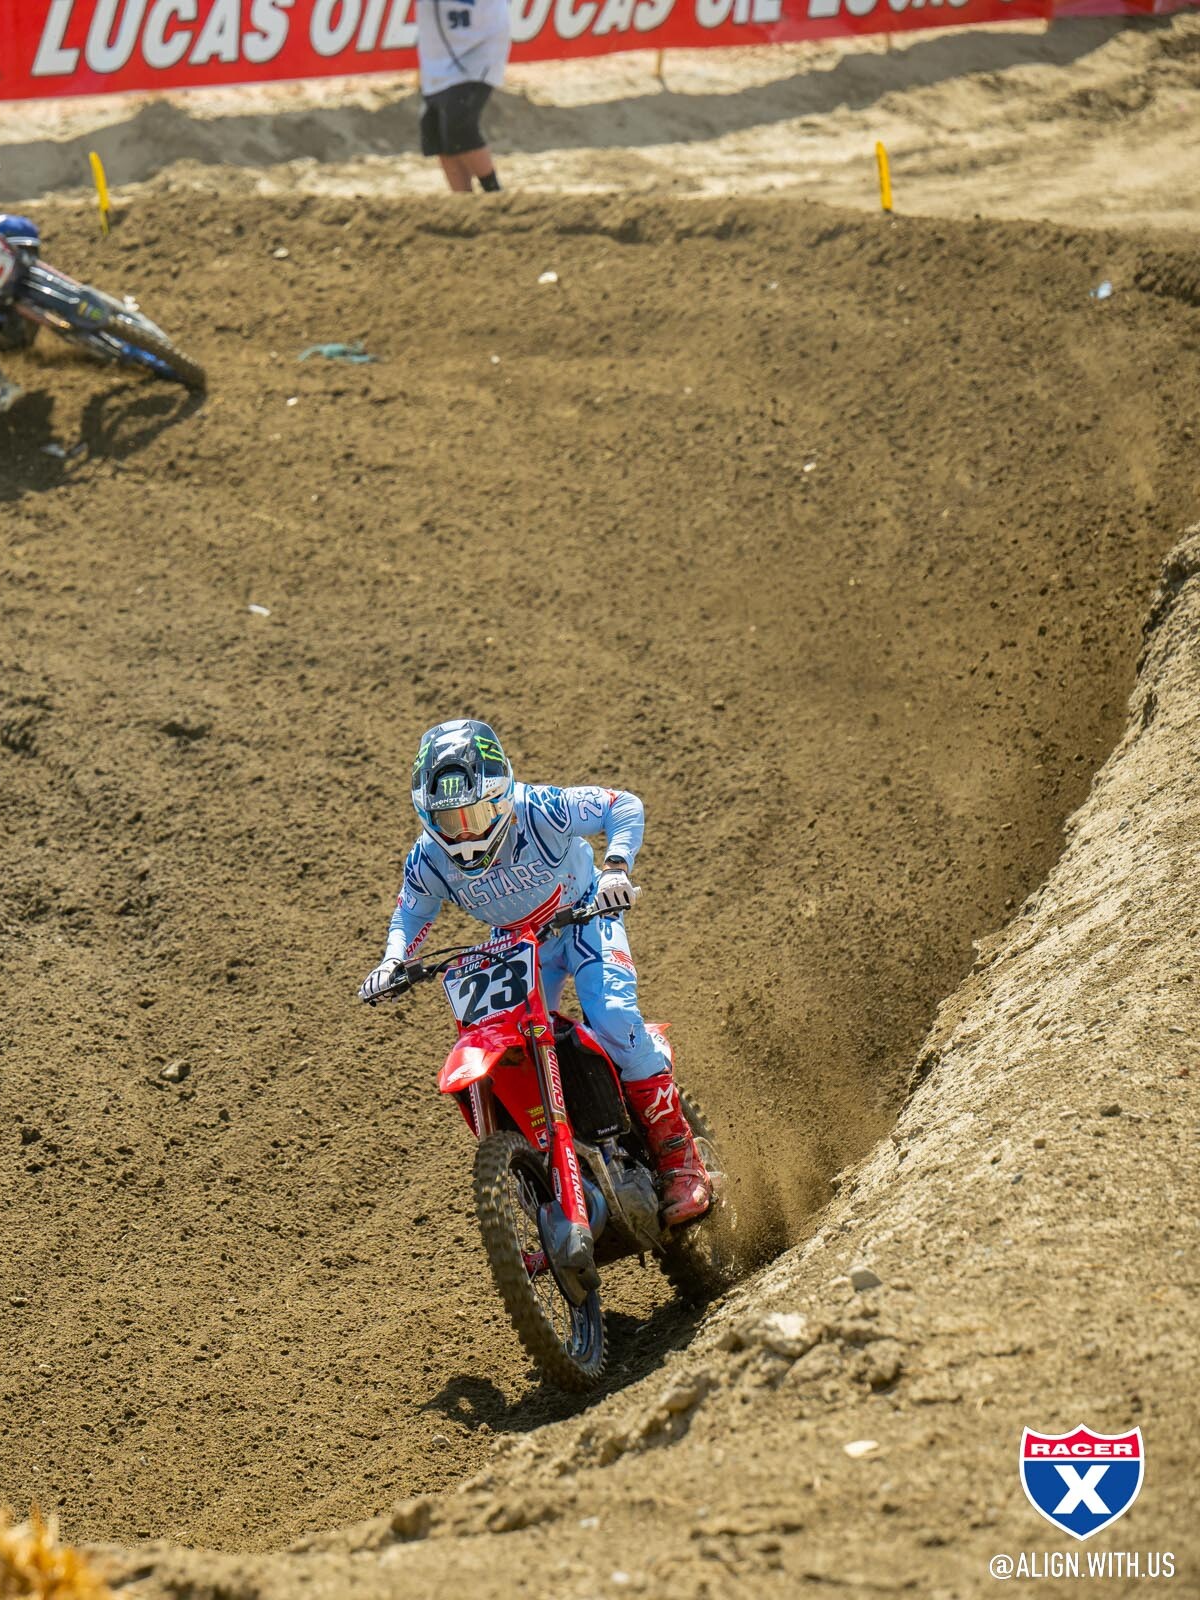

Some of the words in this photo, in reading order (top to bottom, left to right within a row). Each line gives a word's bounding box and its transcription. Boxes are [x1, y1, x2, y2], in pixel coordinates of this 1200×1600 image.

[31, 0, 297, 76] LUCAS
[309, 0, 421, 57] OIL
[507, 0, 677, 43] UCAS
[457, 859, 556, 911] ASTARS
[461, 941, 514, 966] RENHAL
[458, 960, 528, 1028] 23
[564, 1146, 588, 1220] DUNLOP
